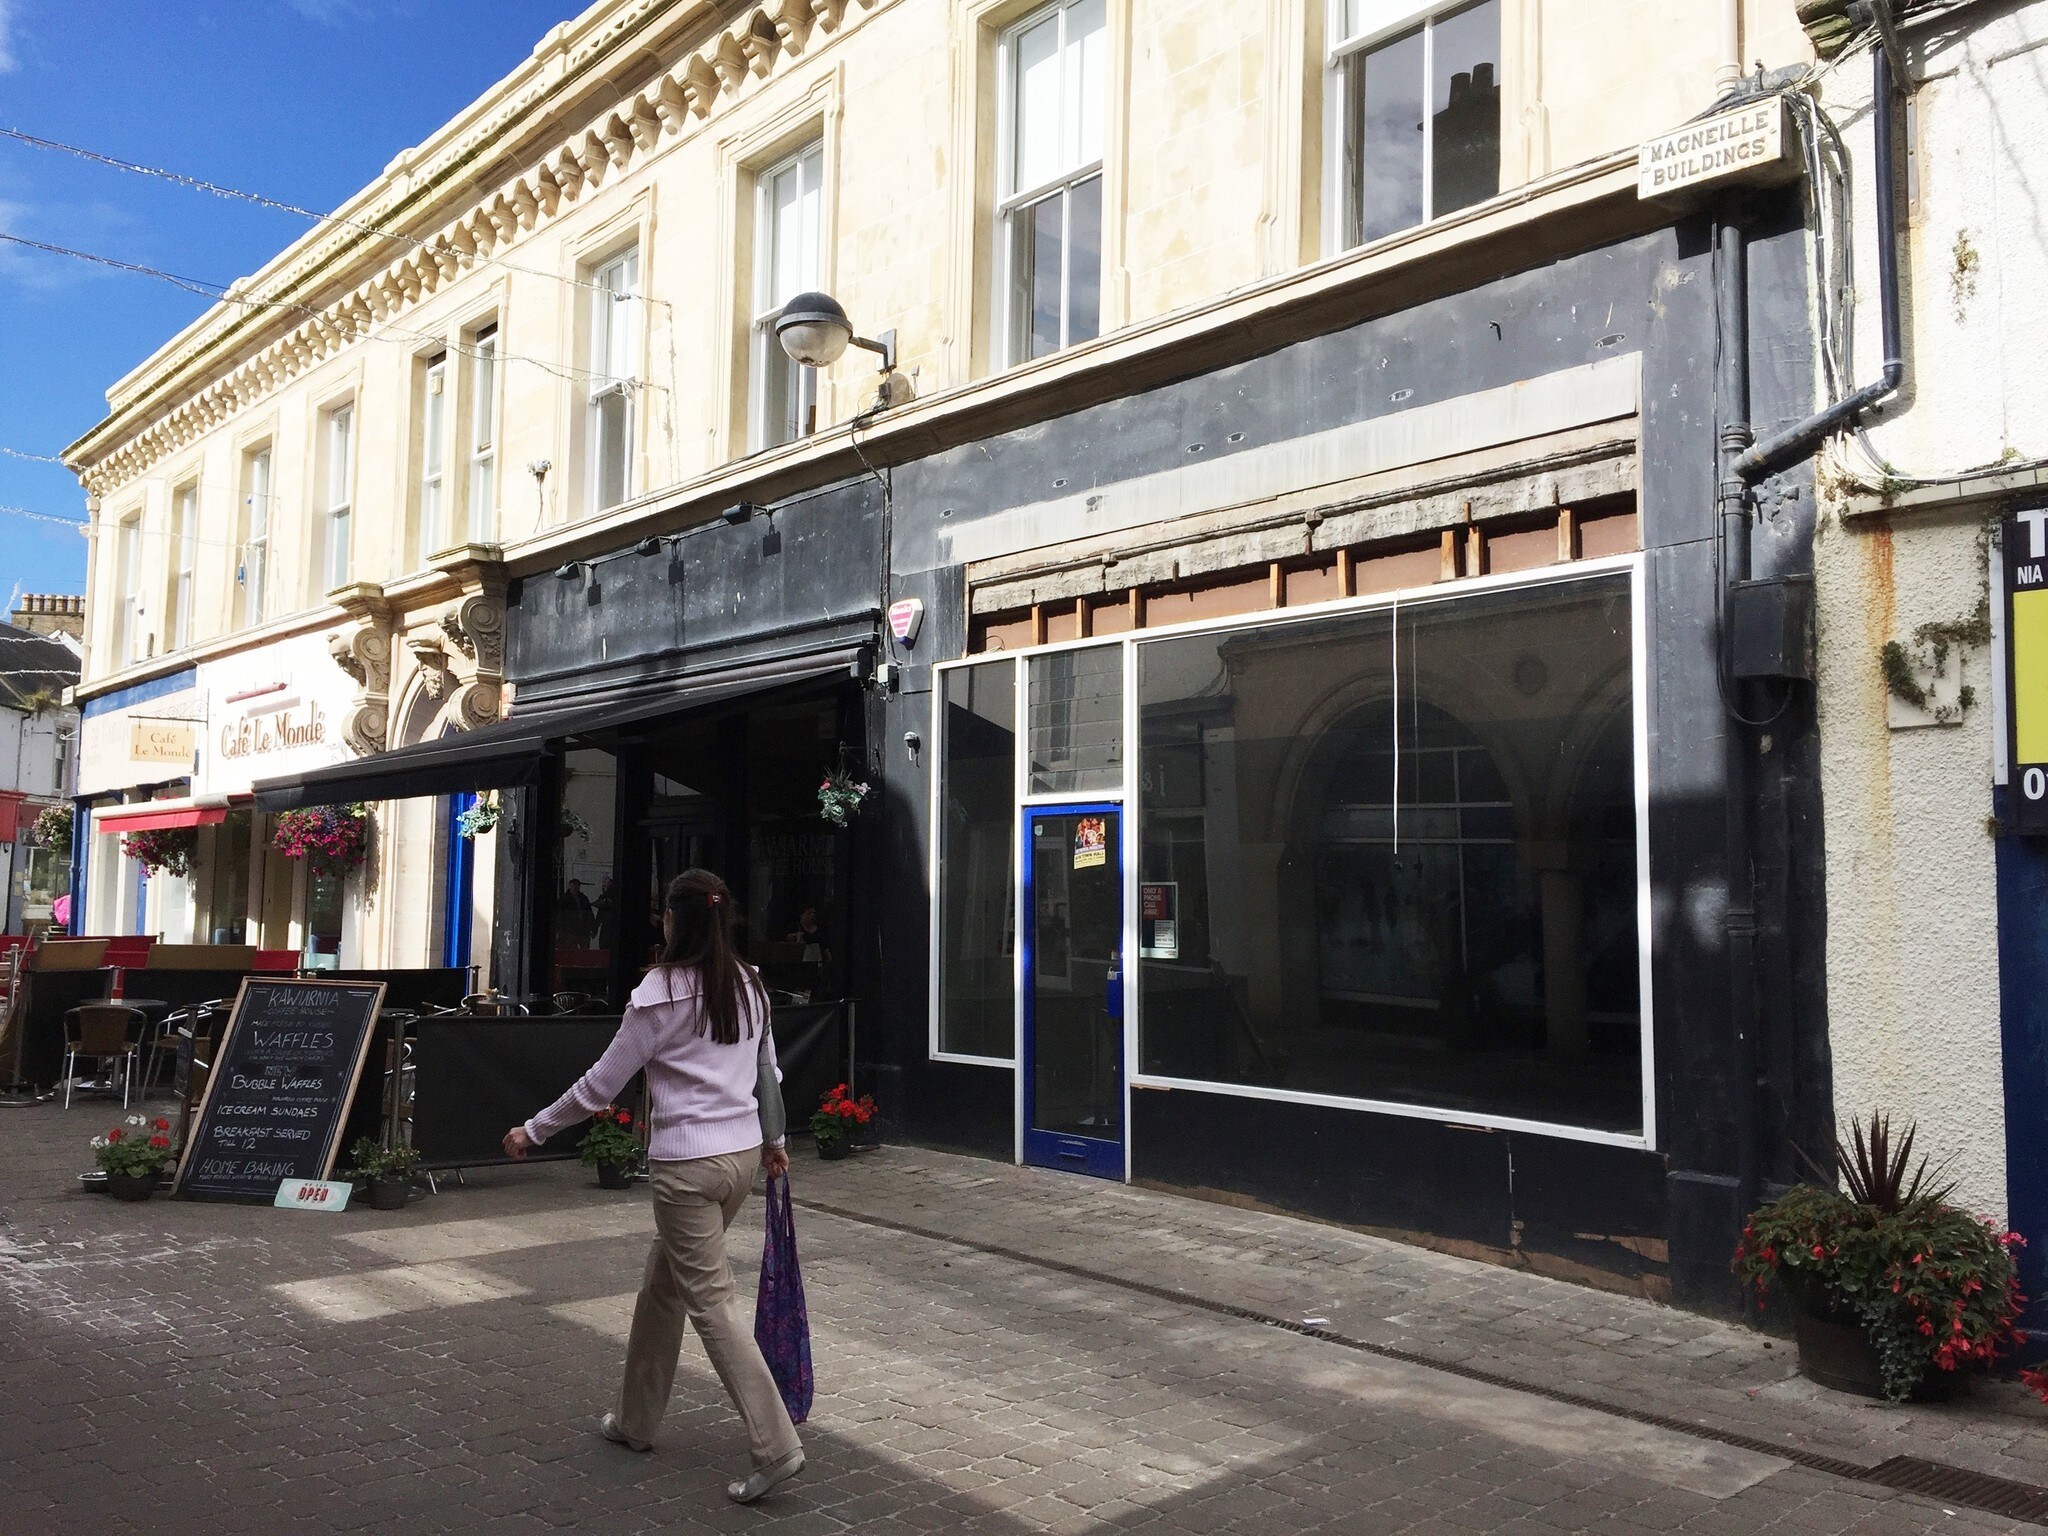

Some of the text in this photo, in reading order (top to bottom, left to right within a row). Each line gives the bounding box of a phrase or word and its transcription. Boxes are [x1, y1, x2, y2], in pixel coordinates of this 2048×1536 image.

[1650, 110, 1769, 163] MACNEILLE
[1653, 137, 1767, 186] BUILDINGS
[2017, 564, 2044, 585] NIA
[150, 732, 177, 744] Café
[221, 717, 251, 758] Café
[254, 718, 270, 752] Le
[134, 744, 149, 756] Le
[2023, 767, 2048, 801] 0
[268, 987, 339, 1007] KAWIARNIA
[254, 1031, 334, 1049] WAFFLES
[264, 1065, 298, 1077] NEW
[216, 1104, 318, 1118] ICE CREAM SUNDAES
[213, 1125, 311, 1140] BREAKFAST SERVED
[218, 1137, 256, 1150] TILL 12
[199, 1158, 295, 1176] HOME BAKING
[298, 1186, 329, 1202] OPEN
